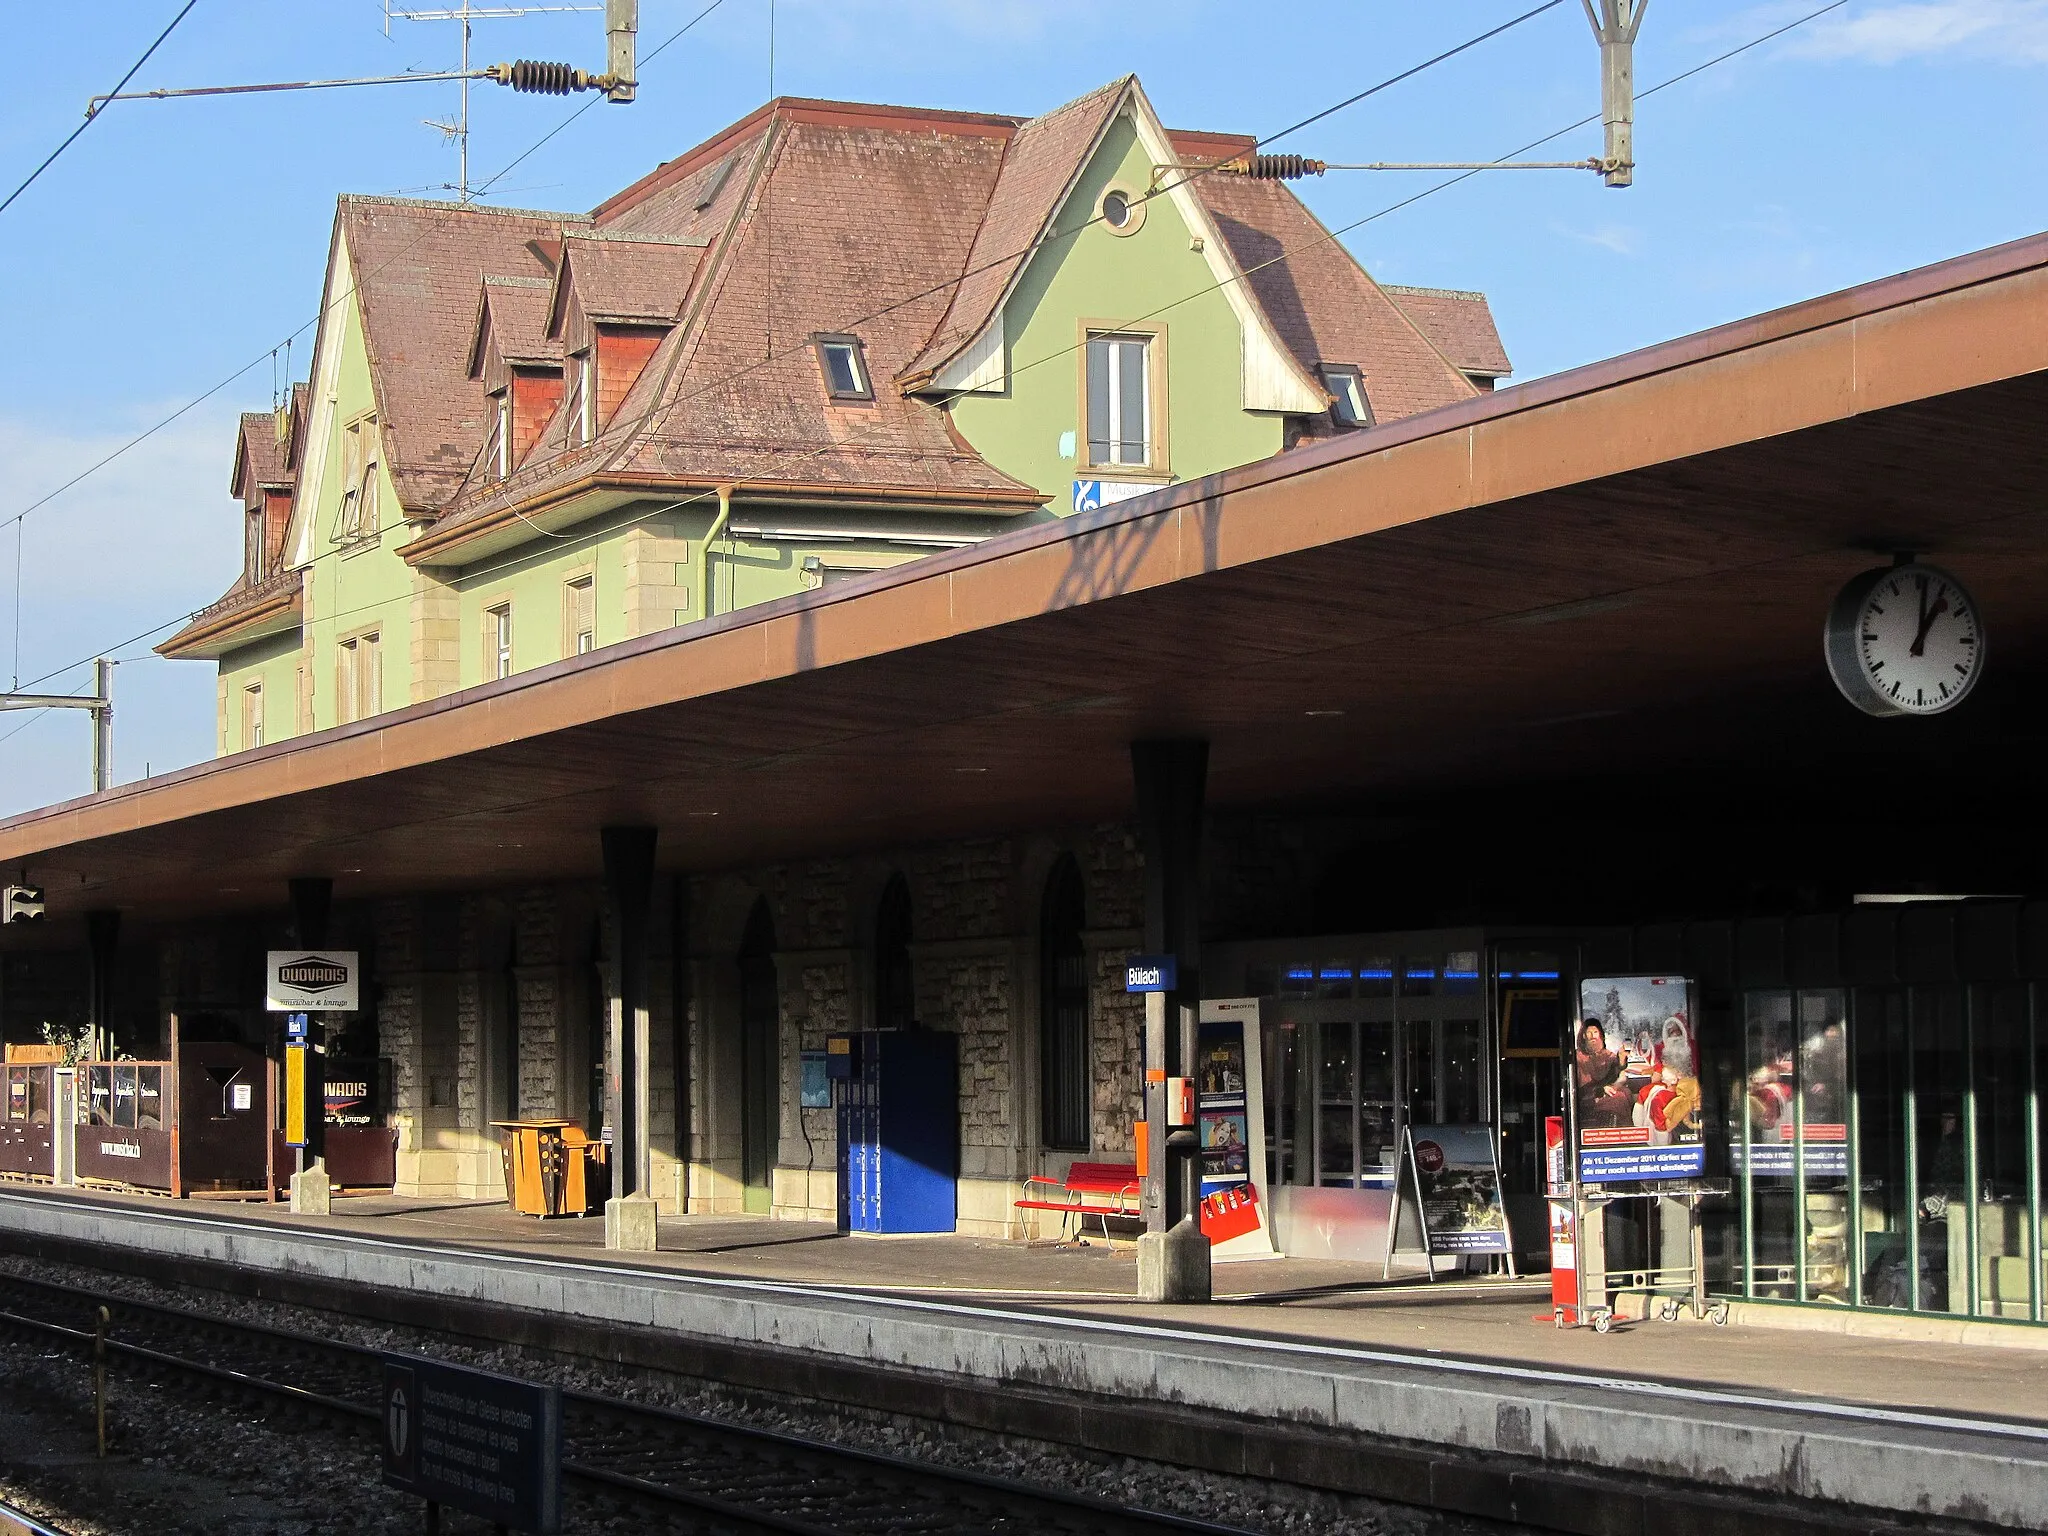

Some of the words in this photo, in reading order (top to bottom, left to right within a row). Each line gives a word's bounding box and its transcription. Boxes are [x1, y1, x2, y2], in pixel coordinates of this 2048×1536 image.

[282, 968, 345, 982] QUOVADIS
[1128, 965, 1160, 986] Bülach
[323, 998, 348, 1007] lounge
[1604, 1156, 1639, 1164] Dezember
[1657, 1154, 1679, 1162] dürfen
[1608, 1166, 1625, 1174] noch
[501, 1407, 532, 1430] verboten
